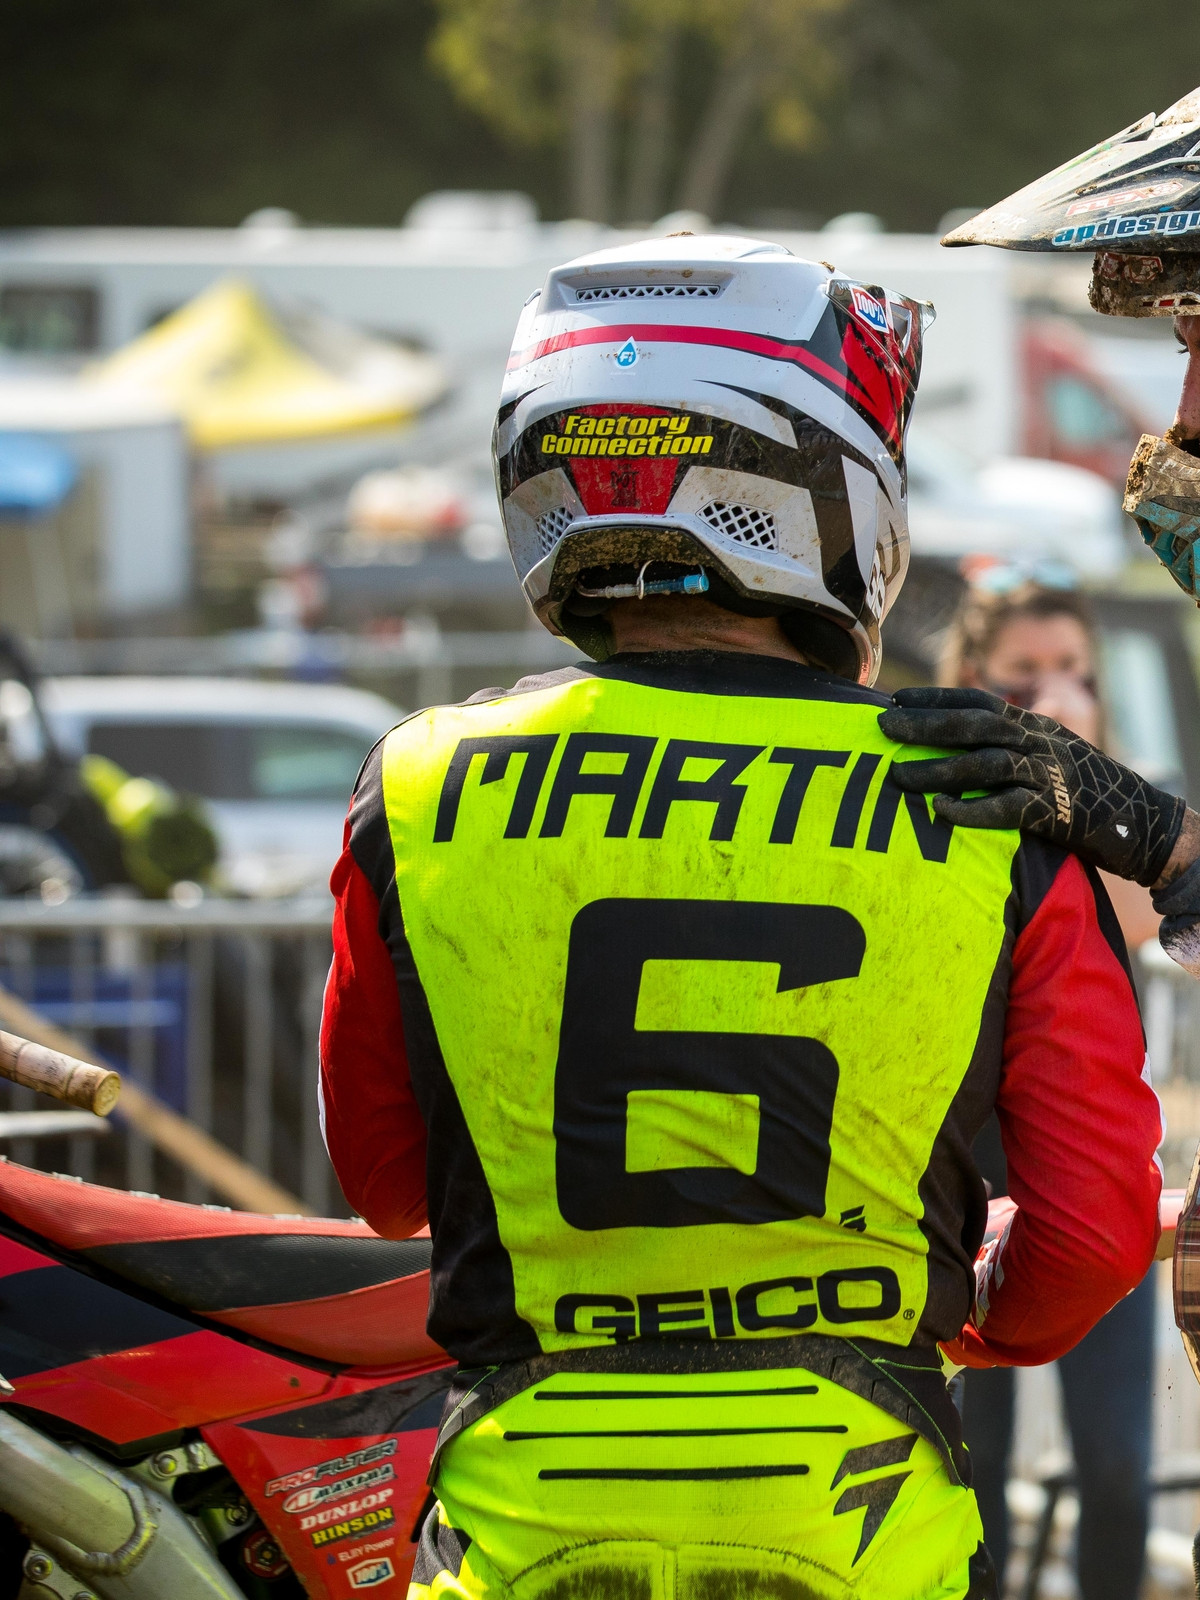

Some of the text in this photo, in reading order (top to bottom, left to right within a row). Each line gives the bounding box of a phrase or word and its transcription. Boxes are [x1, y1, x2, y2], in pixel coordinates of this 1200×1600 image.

[855, 292, 884, 325] 100%
[541, 434, 714, 456] Connection
[564, 415, 691, 436] Factory
[433, 732, 957, 864] MARTIN
[1046, 763, 1071, 824] THOR
[552, 897, 866, 1231] 6
[554, 1266, 902, 1345] GEICO
[300, 1488, 394, 1530] DUNLOP
[311, 1507, 393, 1545] HINSON
